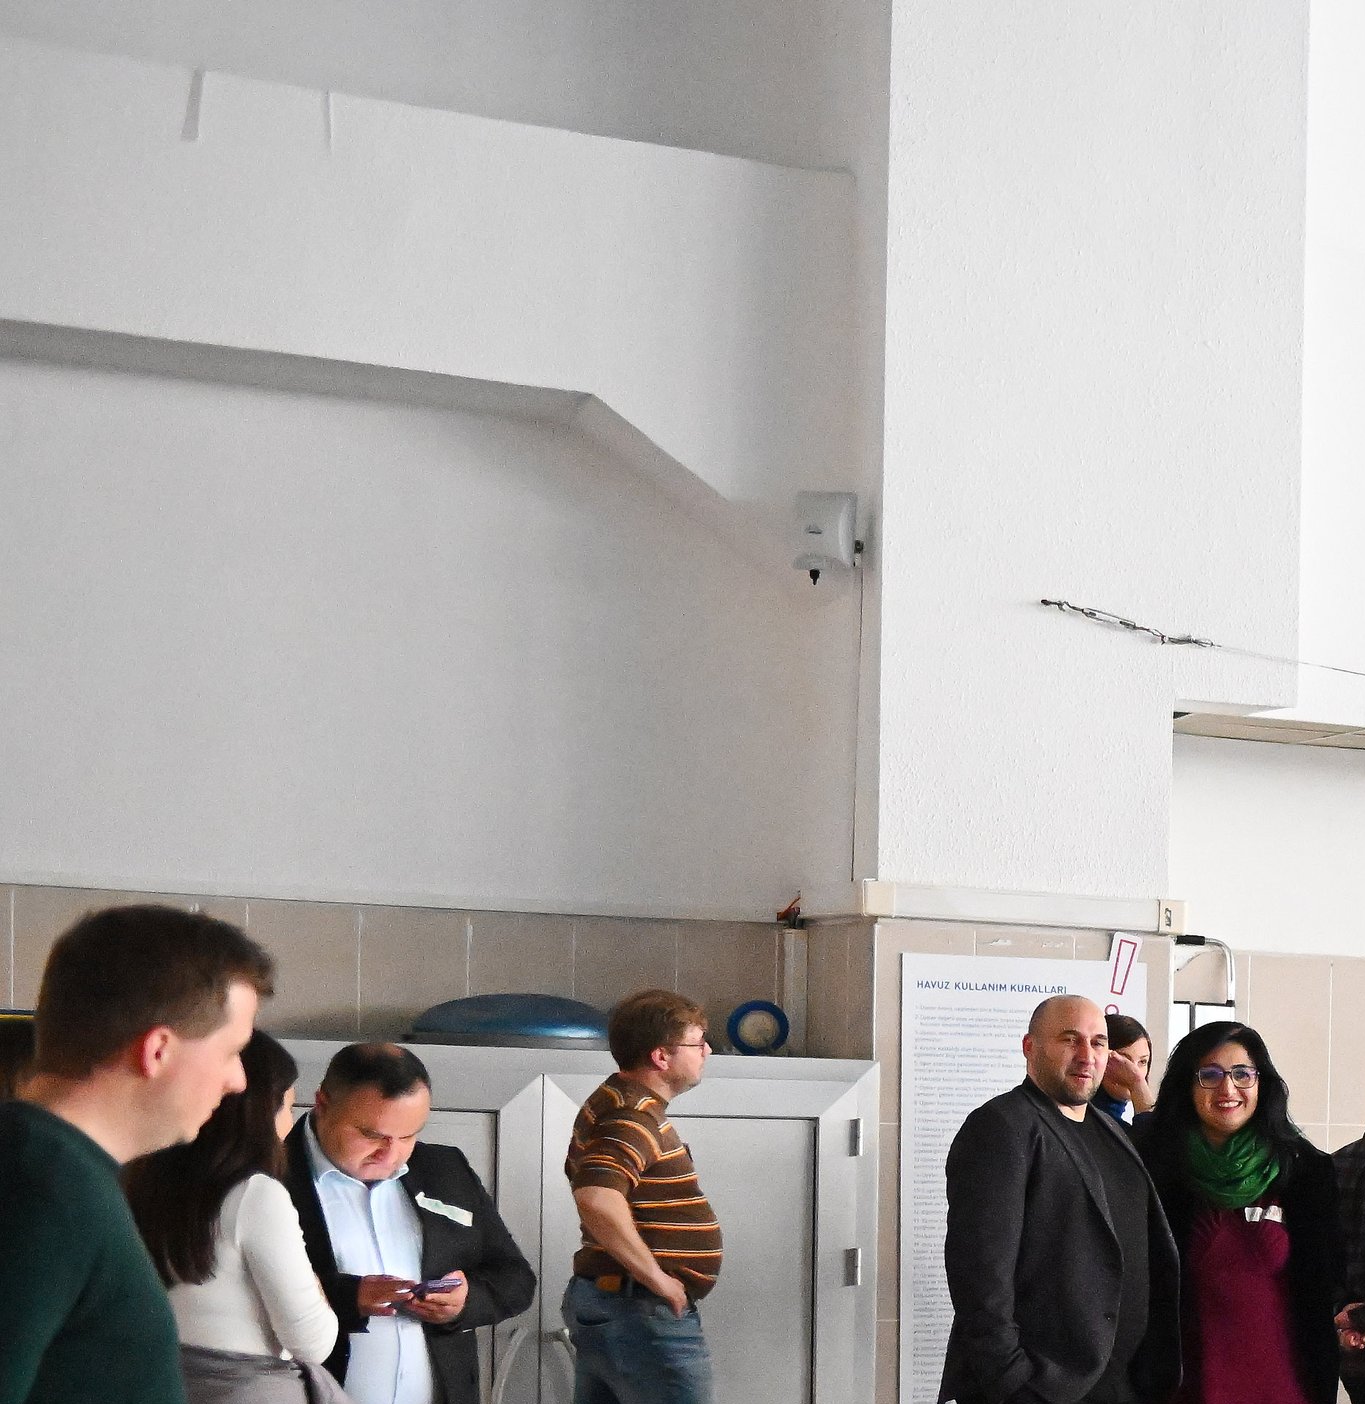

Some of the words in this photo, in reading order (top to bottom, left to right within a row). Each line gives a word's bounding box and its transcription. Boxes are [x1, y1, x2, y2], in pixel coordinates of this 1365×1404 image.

[917, 980, 950, 990] HAVUZ
[954, 981, 1007, 992] KULLANIM
[1010, 984, 1067, 994] KURALLARI
